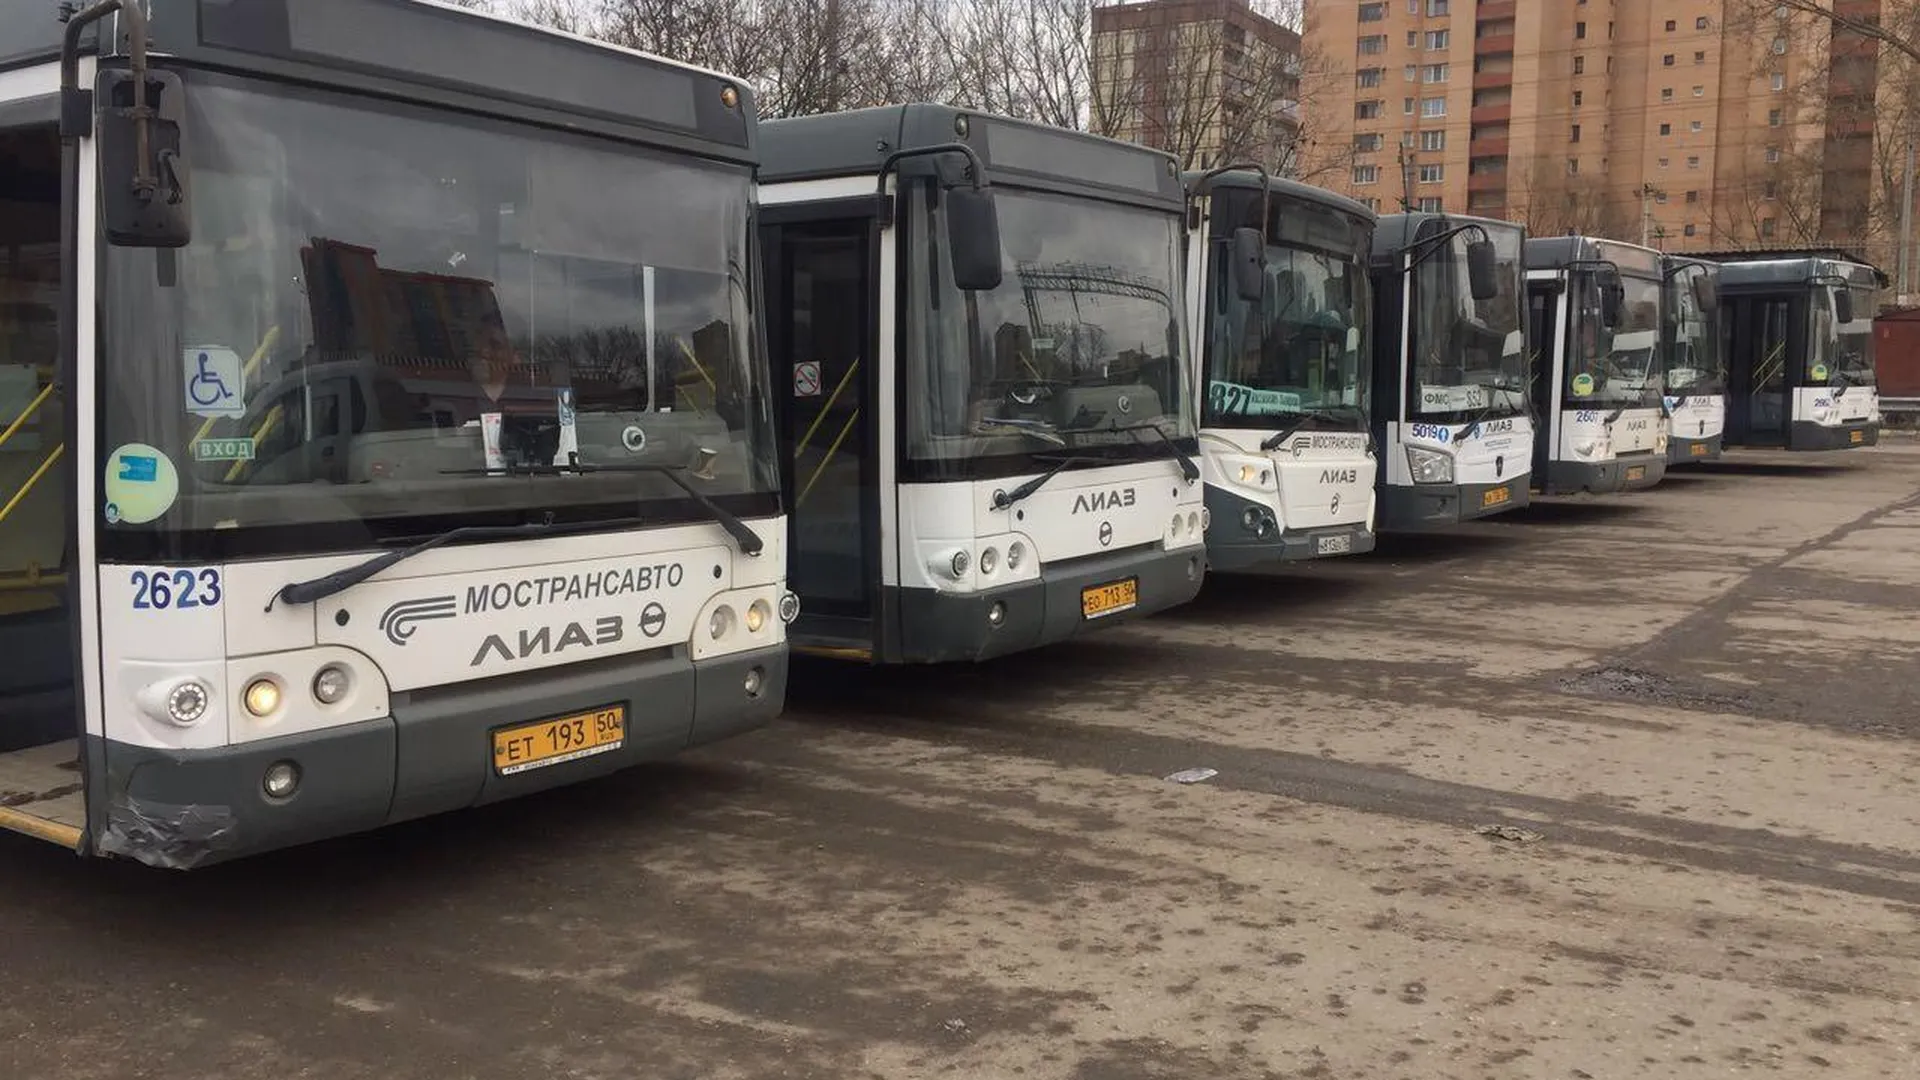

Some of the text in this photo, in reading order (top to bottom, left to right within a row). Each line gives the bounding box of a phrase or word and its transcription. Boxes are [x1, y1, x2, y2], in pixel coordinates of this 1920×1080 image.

[1210, 384, 1252, 416] 827
[1411, 423, 1438, 439] 5019
[1486, 419, 1513, 433] ЛИАЗ
[200, 441, 250, 458] ВХОД
[1312, 435, 1362, 450] МОСТРАНСАВТО
[1320, 469, 1357, 484] ЛИАЗ
[1071, 487, 1136, 516] ЛИАЗ
[130, 568, 222, 609] 2623
[464, 562, 684, 615] МОСТРАНСАВТО
[469, 614, 624, 667] ЛИАЗ
[546, 719, 585, 751] 193
[597, 711, 617, 733] 50
